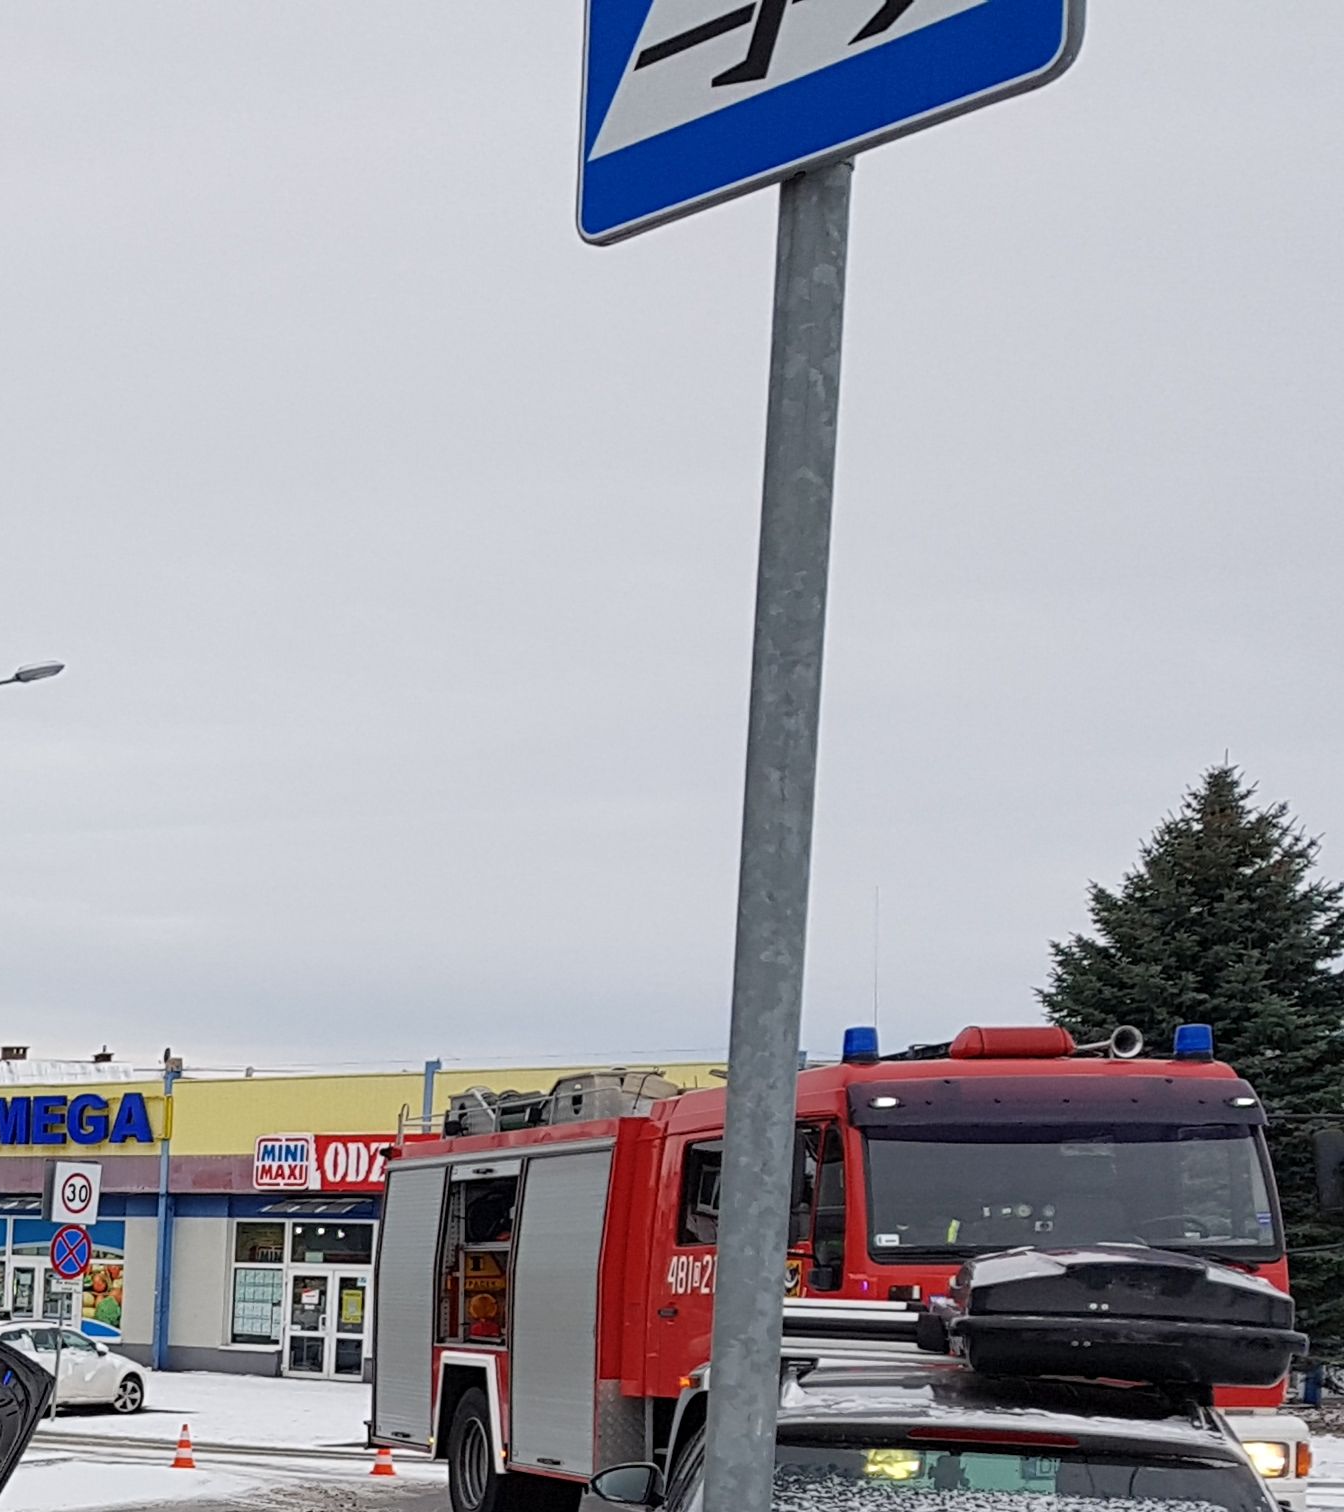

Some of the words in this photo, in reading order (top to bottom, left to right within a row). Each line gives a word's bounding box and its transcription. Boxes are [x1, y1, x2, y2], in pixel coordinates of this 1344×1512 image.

[261, 1144, 305, 1163] MINI
[323, 1142, 395, 1183] ODZ
[260, 1164, 303, 1181] MAXI
[66, 1182, 89, 1203] 30
